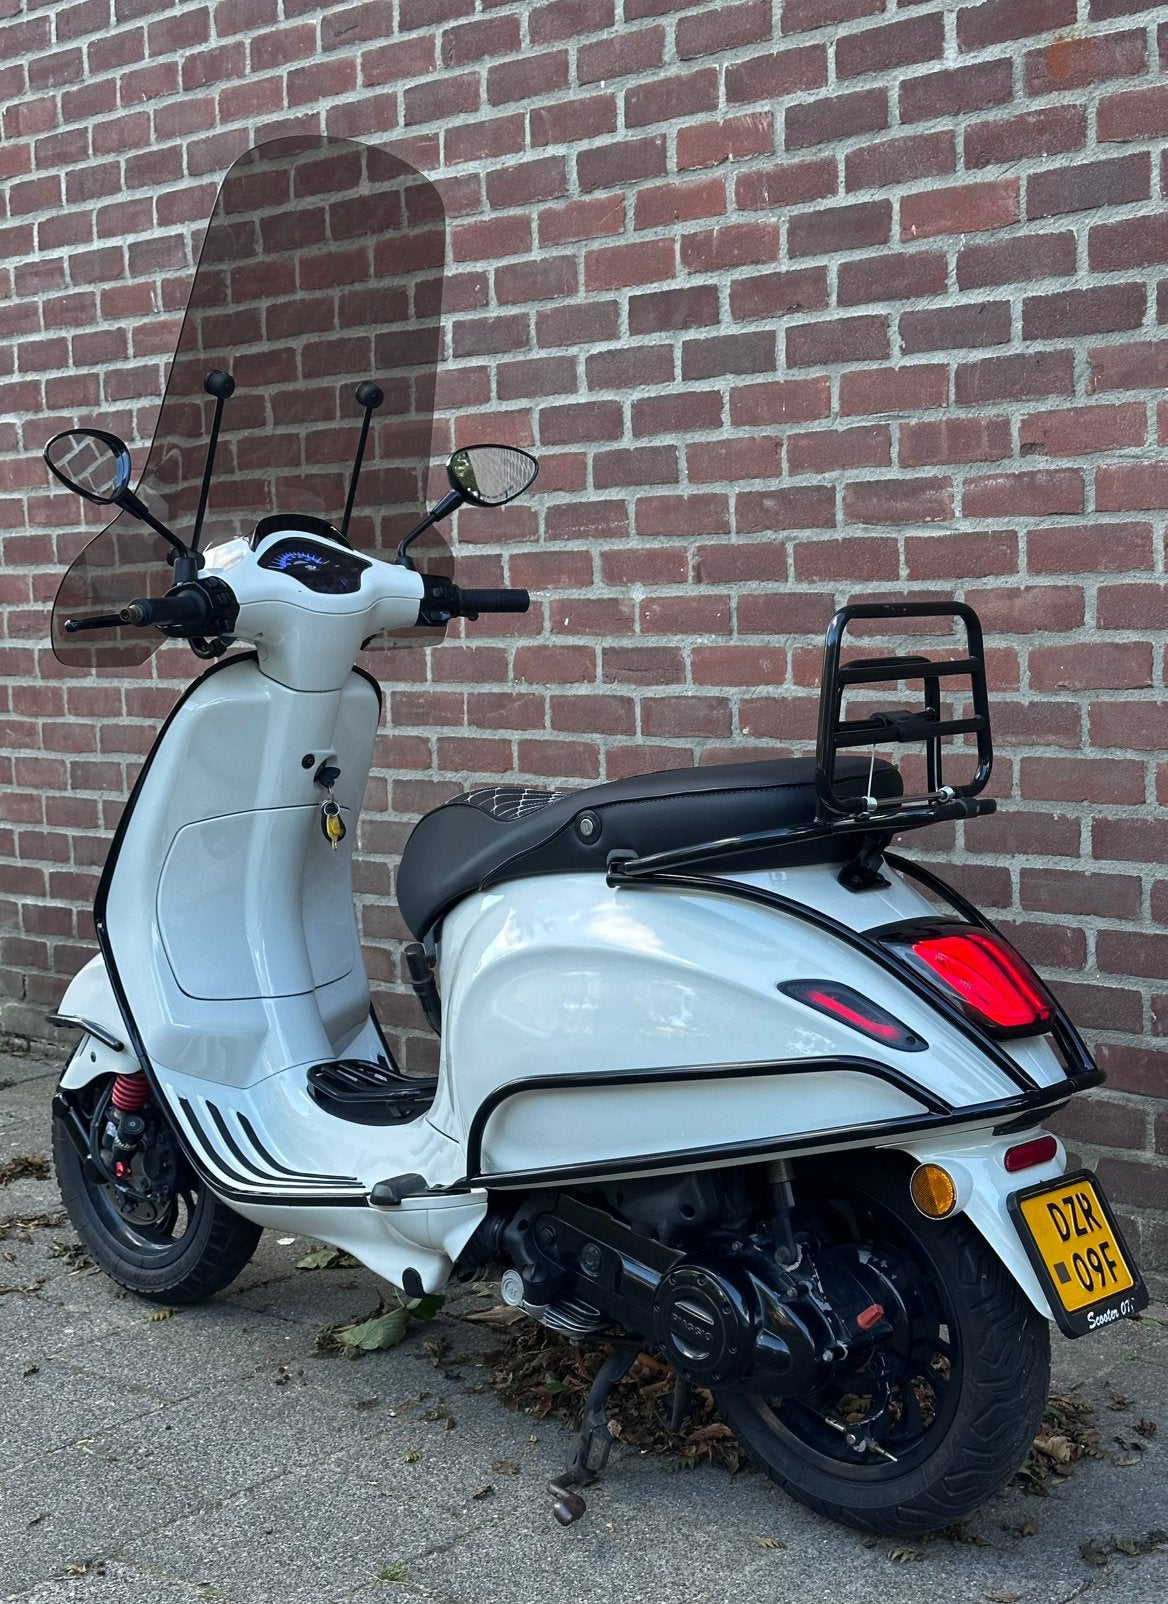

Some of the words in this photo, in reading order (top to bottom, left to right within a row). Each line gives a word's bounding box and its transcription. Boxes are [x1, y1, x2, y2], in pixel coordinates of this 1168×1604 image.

[1046, 1192, 1103, 1242] DZR
[1071, 1241, 1118, 1293] 09F
[671, 1312, 713, 1342] PIAGGIO
[1087, 1308, 1120, 1330] Scooter
